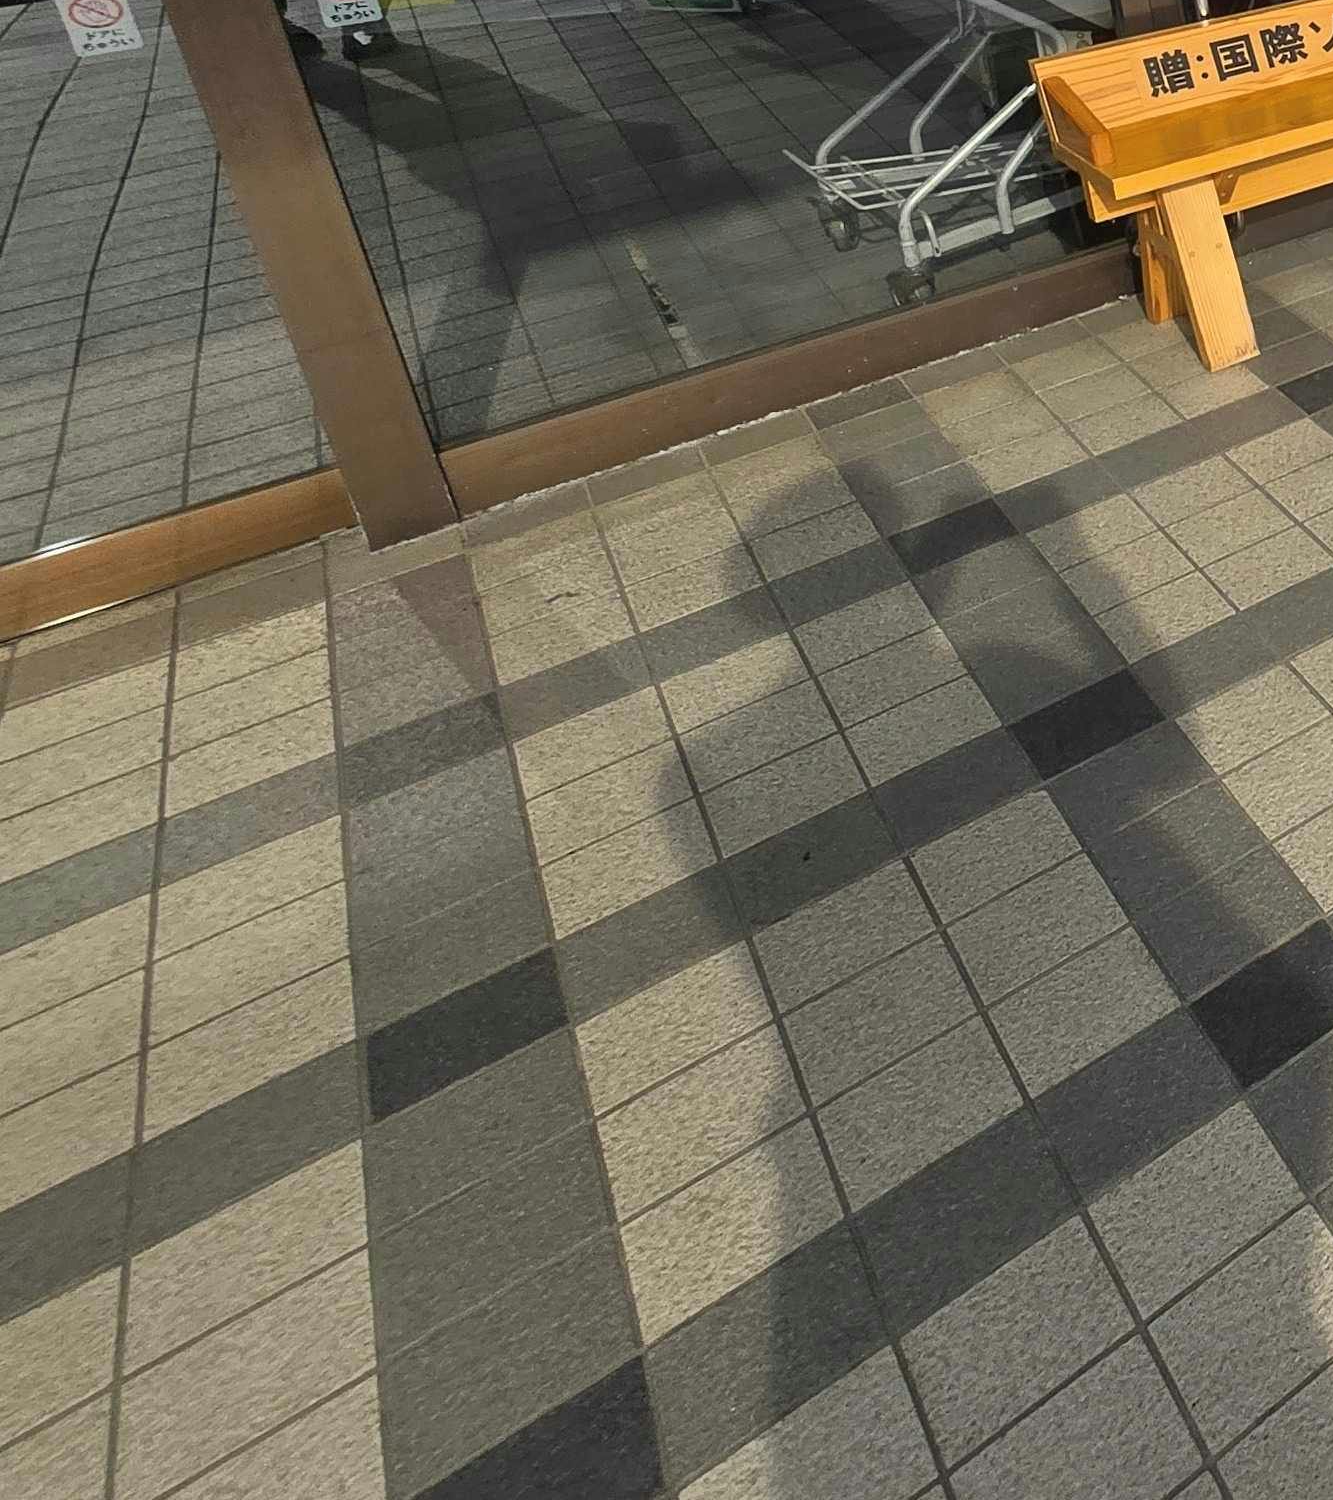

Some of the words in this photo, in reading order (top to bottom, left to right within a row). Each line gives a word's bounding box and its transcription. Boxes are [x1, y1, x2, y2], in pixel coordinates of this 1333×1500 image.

[332, 0, 368, 11] ドアに
[329, 8, 375, 23] ちゅうい
[85, 29, 125, 41] ドアに
[83, 37, 135, 52] ちゅうい
